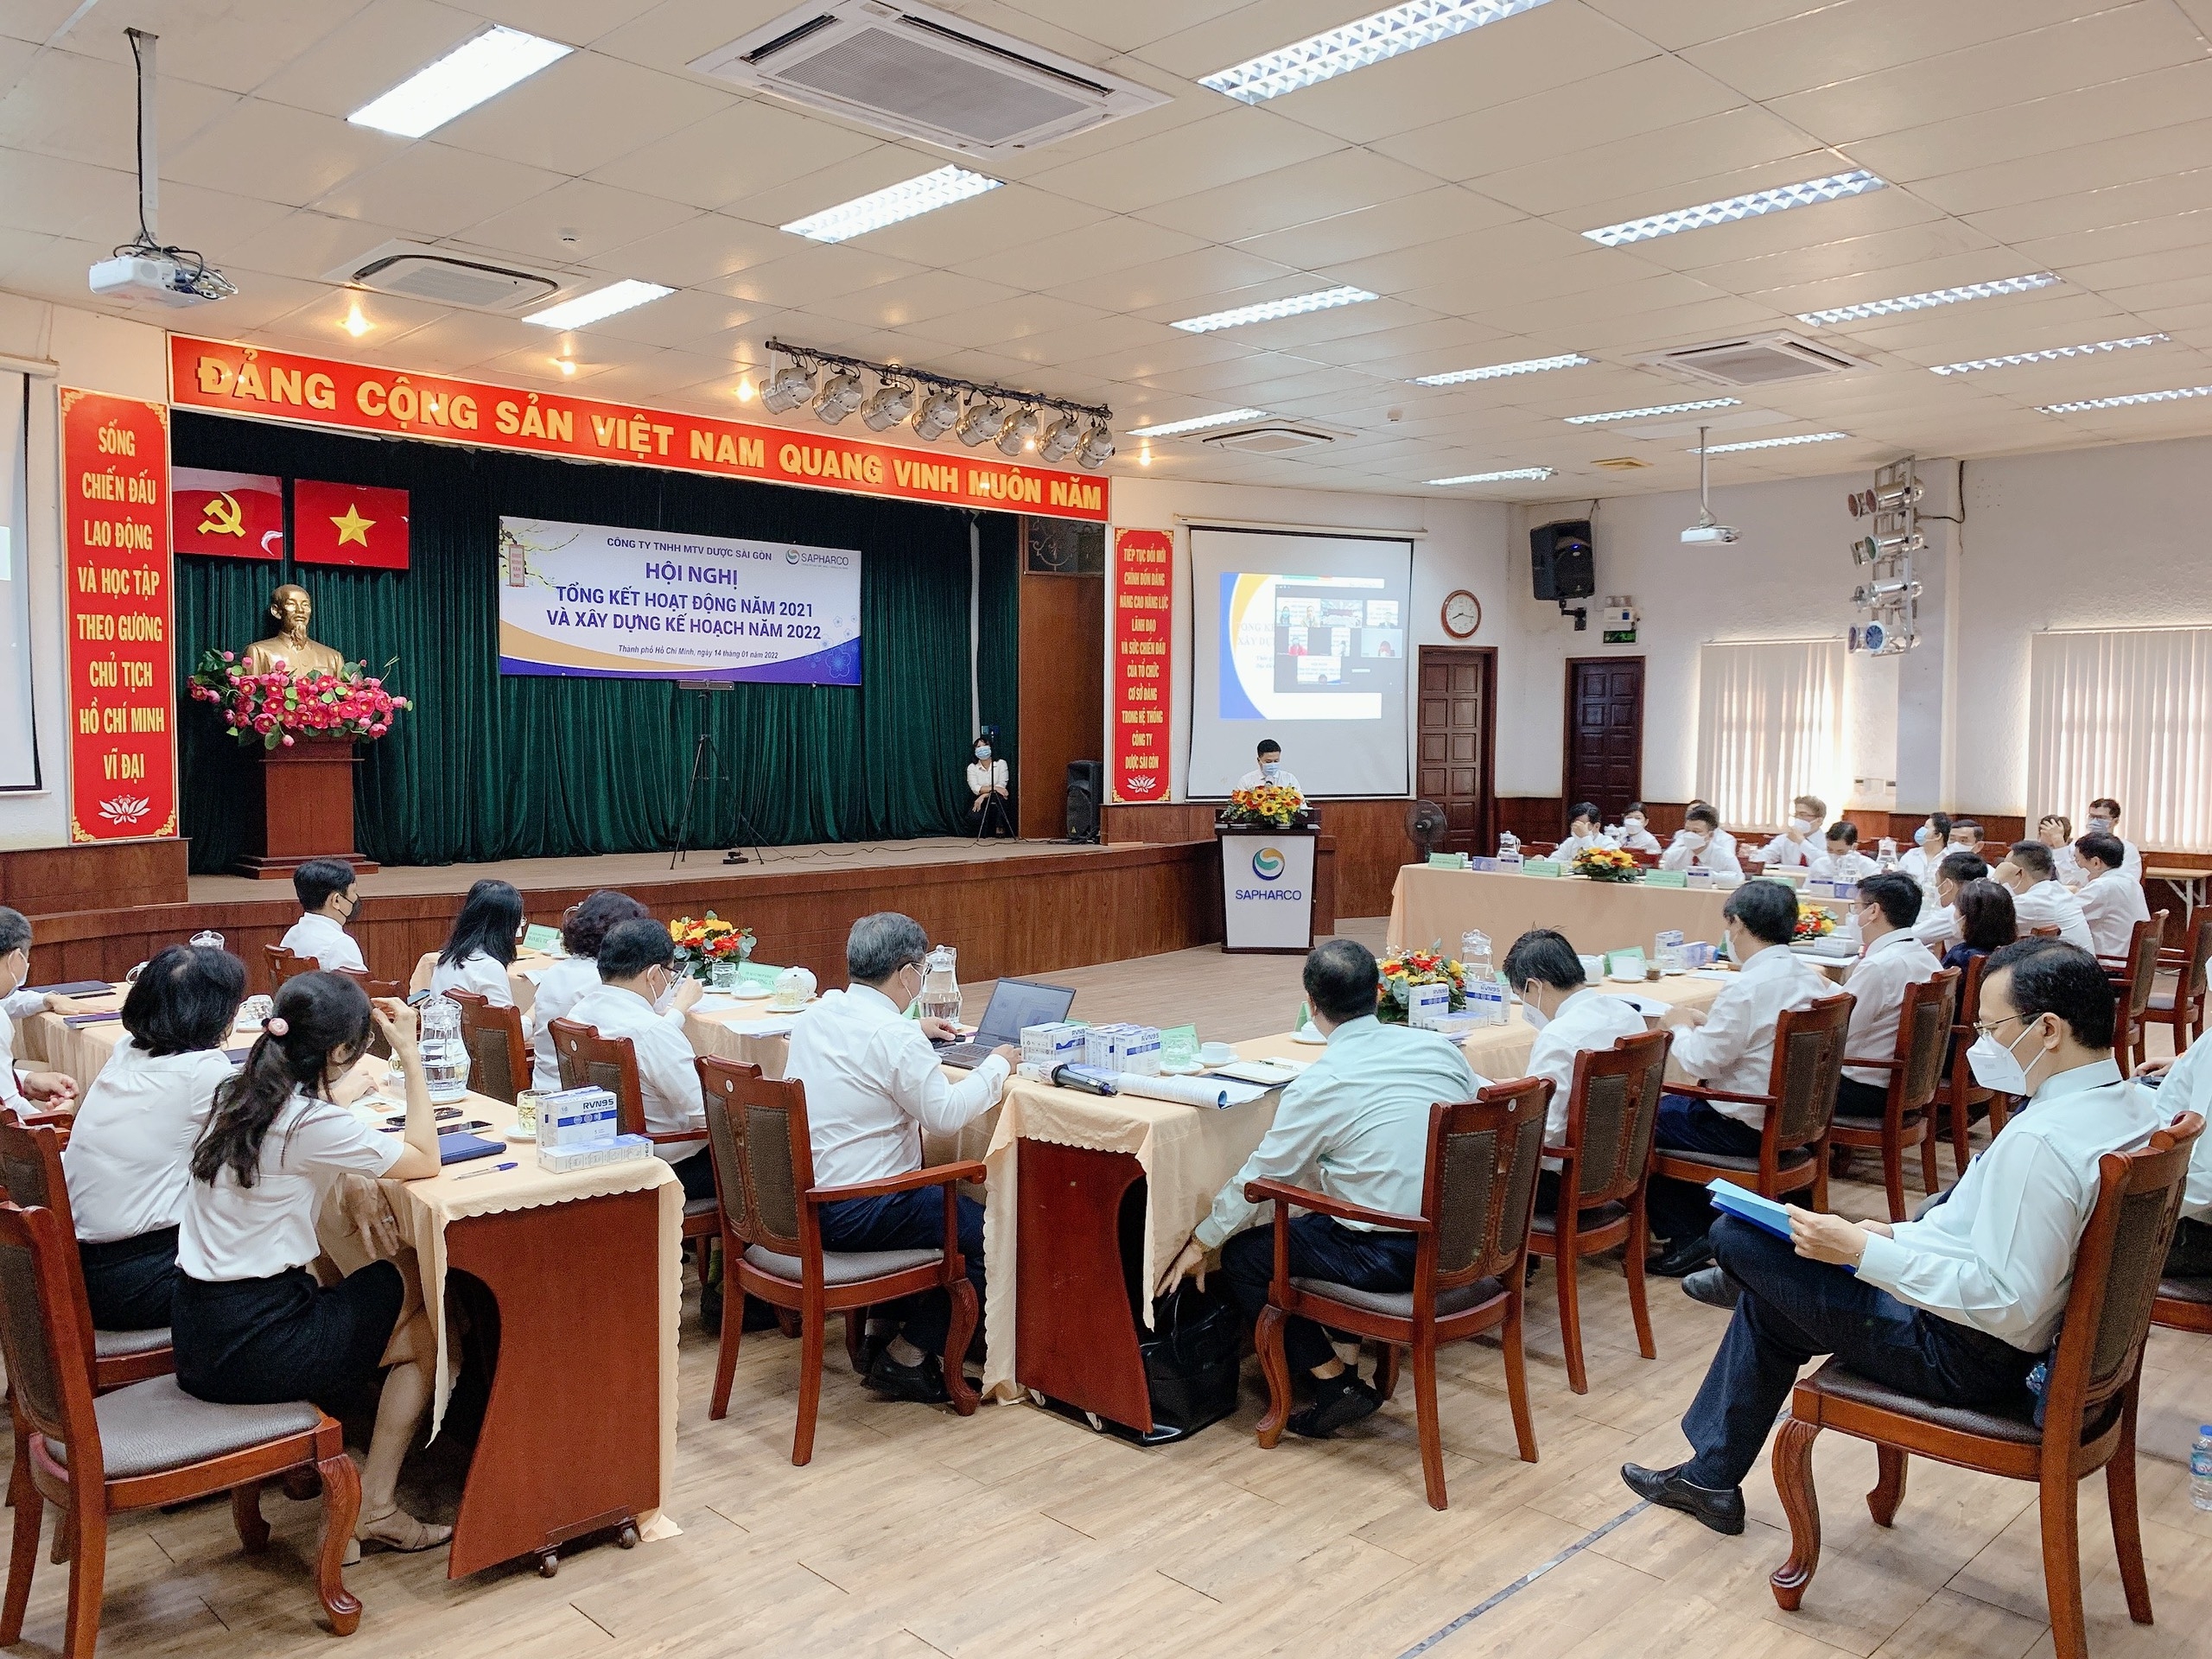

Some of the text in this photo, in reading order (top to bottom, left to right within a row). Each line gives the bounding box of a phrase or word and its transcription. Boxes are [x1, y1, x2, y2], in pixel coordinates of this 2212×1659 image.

[98, 419, 136, 456] SỐNG
[196, 348, 1102, 510] ĐẢNG CỘNG SẢN VIỆT NAM QUANG VINH MUÔN NĂM
[82, 465, 156, 505] CHIẾN ĐẤU
[84, 516, 152, 554] LAO ĐỘNG
[607, 537, 772, 560] CÔNG TY TNHH MTV DƯỢC SÀI GÒN
[645, 560, 737, 589] HỘI NGHỊ
[801, 552, 849, 566] SAPHARCO
[77, 560, 160, 601] VÀ HỌC TẬP
[556, 582, 812, 617] TỔNG KẾT HOẠT ĐỘNG NĂM 2021
[77, 611, 162, 642] THEO GƯƠNG
[546, 607, 821, 639] VÀ XÂY DỰNG KẾ HOẠCH NĂM 2022
[619, 645, 639, 653] Thành
[722, 649, 741, 658] tháng
[89, 652, 152, 693] CHỦ TỊCH
[79, 696, 164, 734] HỒ CHÍ MINH
[103, 747, 145, 784] VĨ ĐẠI
[1236, 889, 1302, 900] SAPHARCO
[1071, 1027, 1088, 1036] RVN9
[582, 1098, 614, 1109] RVN95
